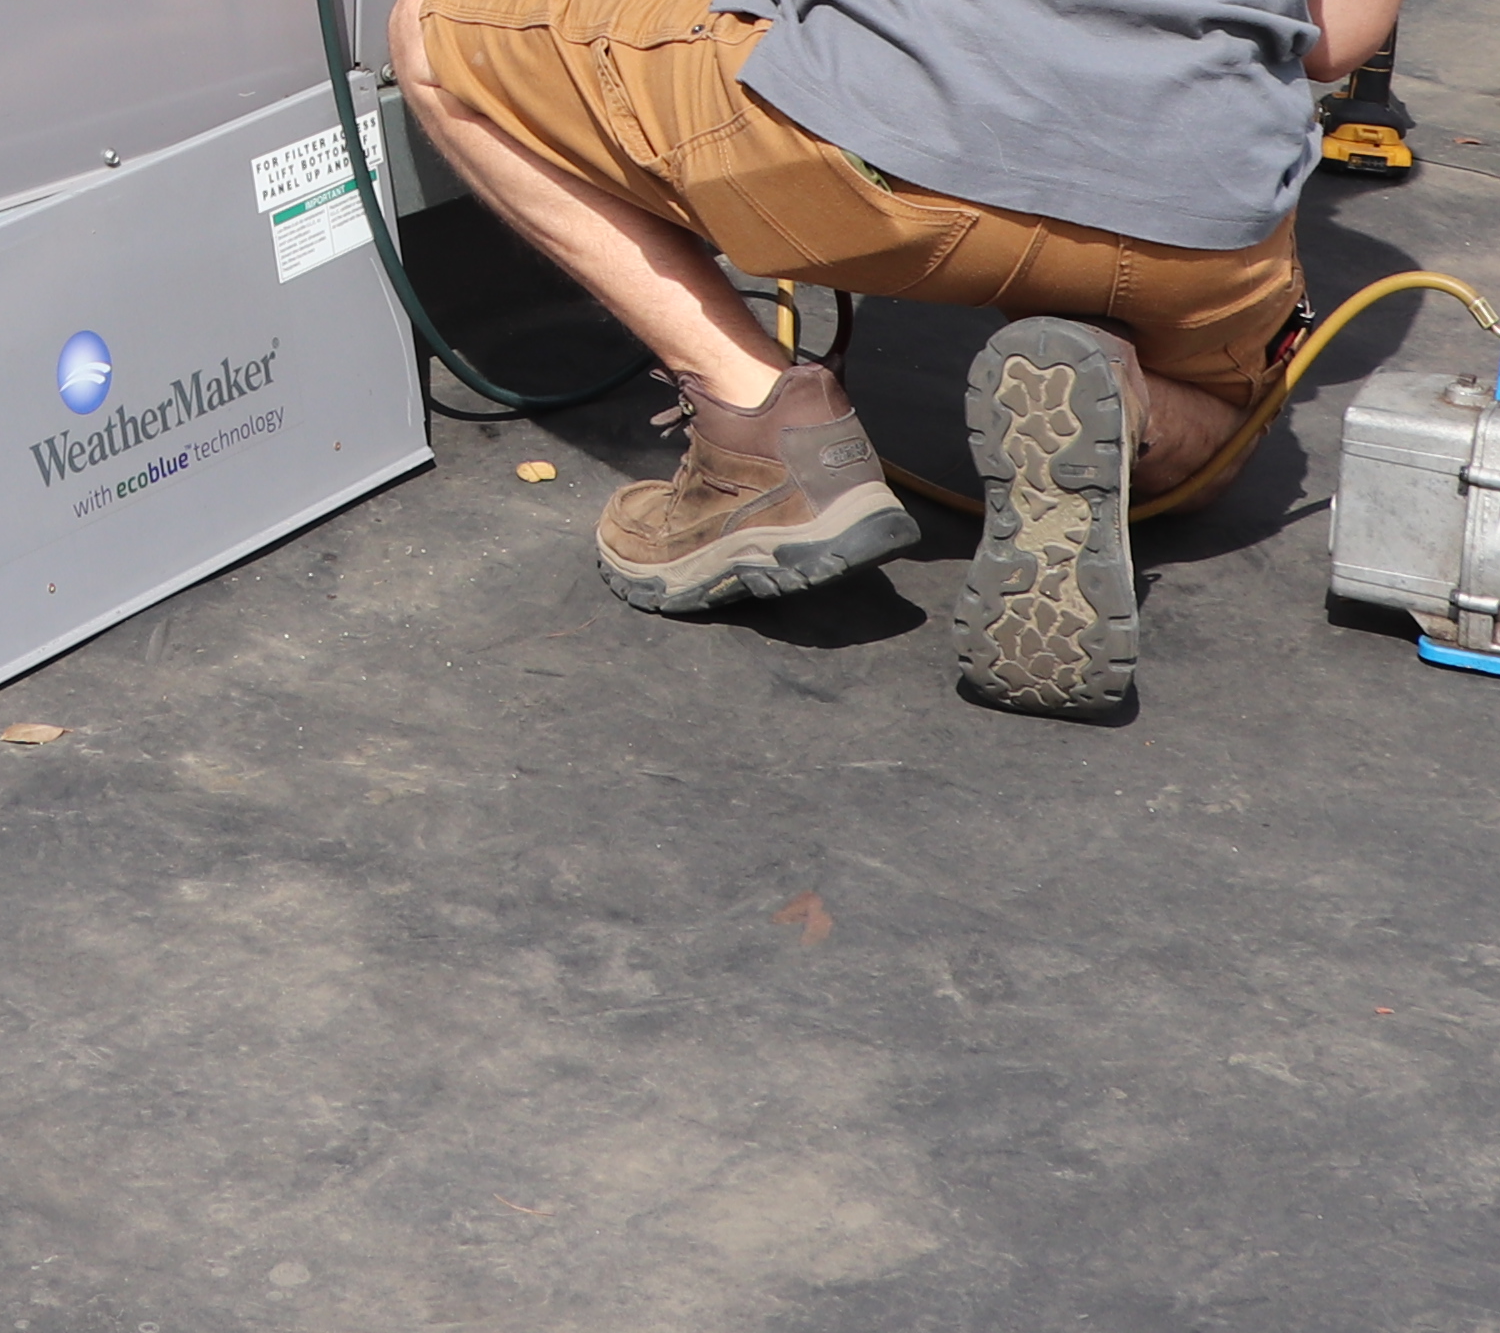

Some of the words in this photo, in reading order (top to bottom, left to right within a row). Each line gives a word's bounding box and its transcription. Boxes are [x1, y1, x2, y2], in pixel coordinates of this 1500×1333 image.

[256, 156, 279, 174] FOR
[284, 137, 327, 163] FILTER
[268, 164, 294, 184] LIFT
[262, 177, 300, 201] PANEL
[305, 168, 321, 183] UP
[327, 157, 350, 175] AND
[304, 184, 346, 211] IMPORTANT
[72, 484, 114, 518] with
[193, 406, 285, 462] technology
